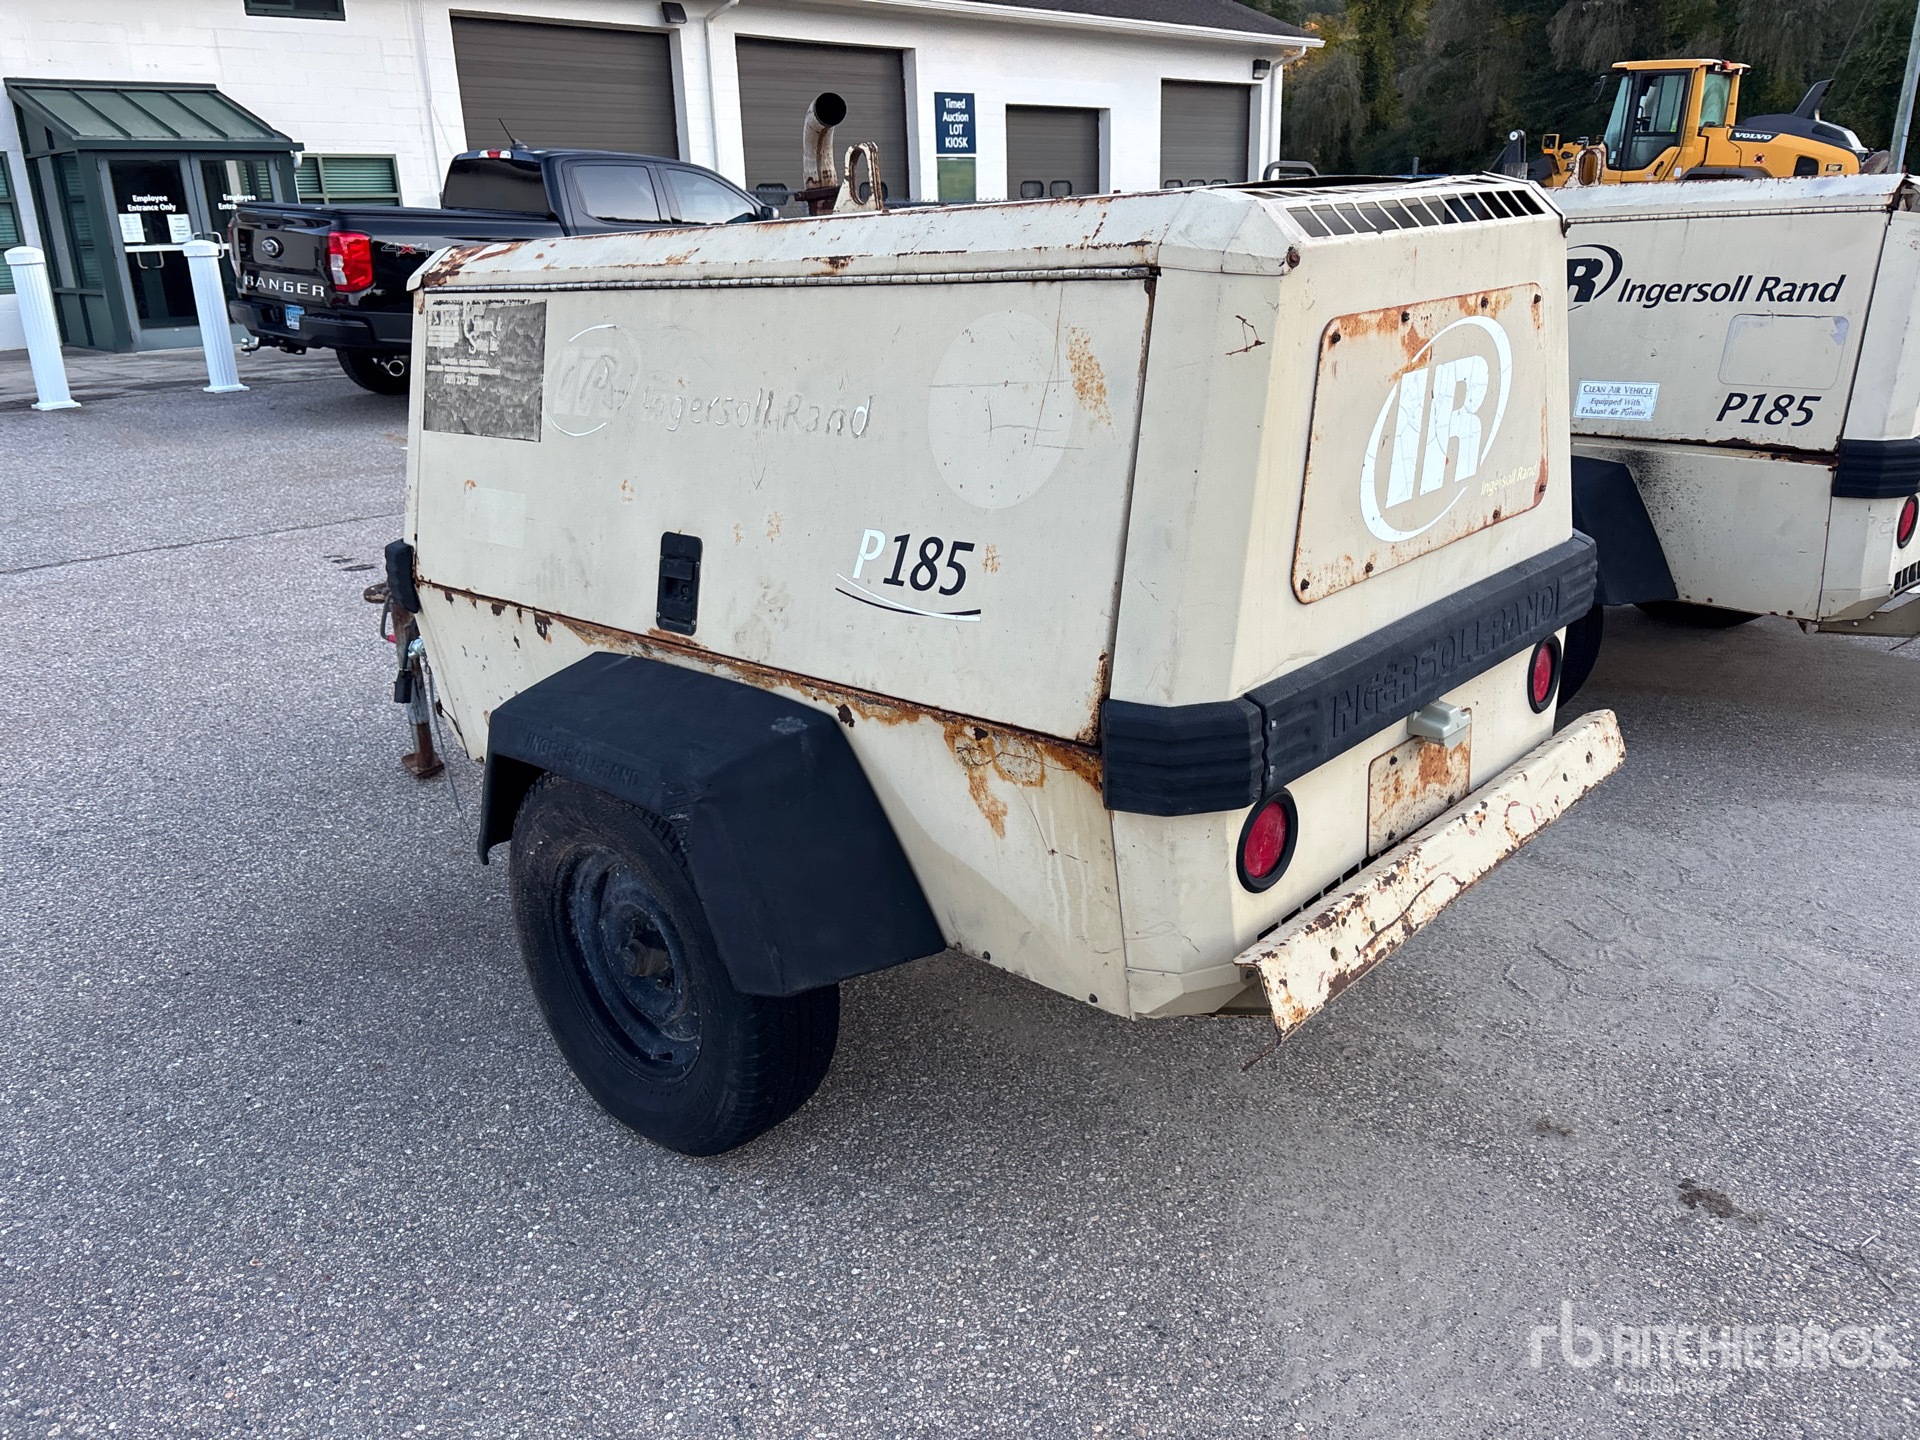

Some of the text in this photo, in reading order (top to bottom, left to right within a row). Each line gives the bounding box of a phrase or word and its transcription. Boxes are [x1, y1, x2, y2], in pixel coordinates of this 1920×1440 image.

[944, 98, 966, 109] Timed
[942, 112, 969, 122] Auction
[949, 124, 963, 135] LOT
[1734, 131, 1773, 140] VOLVO
[945, 137, 968, 148] KIOSK
[132, 194, 168, 203] Employee
[222, 193, 256, 202] Employee
[127, 203, 176, 212] Entrance Only
[244, 275, 325, 297] RANGER
[1617, 274, 1847, 308] Ingersoll Rand
[1583, 384, 1653, 395] CLEAN AIR VEHICLE
[1590, 398, 1641, 406] Equipped With
[782, 391, 875, 438] Rand
[1581, 407, 1607, 415] Exhaust
[1608, 407, 1619, 415] Air
[1715, 392, 1822, 427] P185
[1480, 460, 1538, 497] Ingersoll Rand
[852, 528, 976, 596] P185
